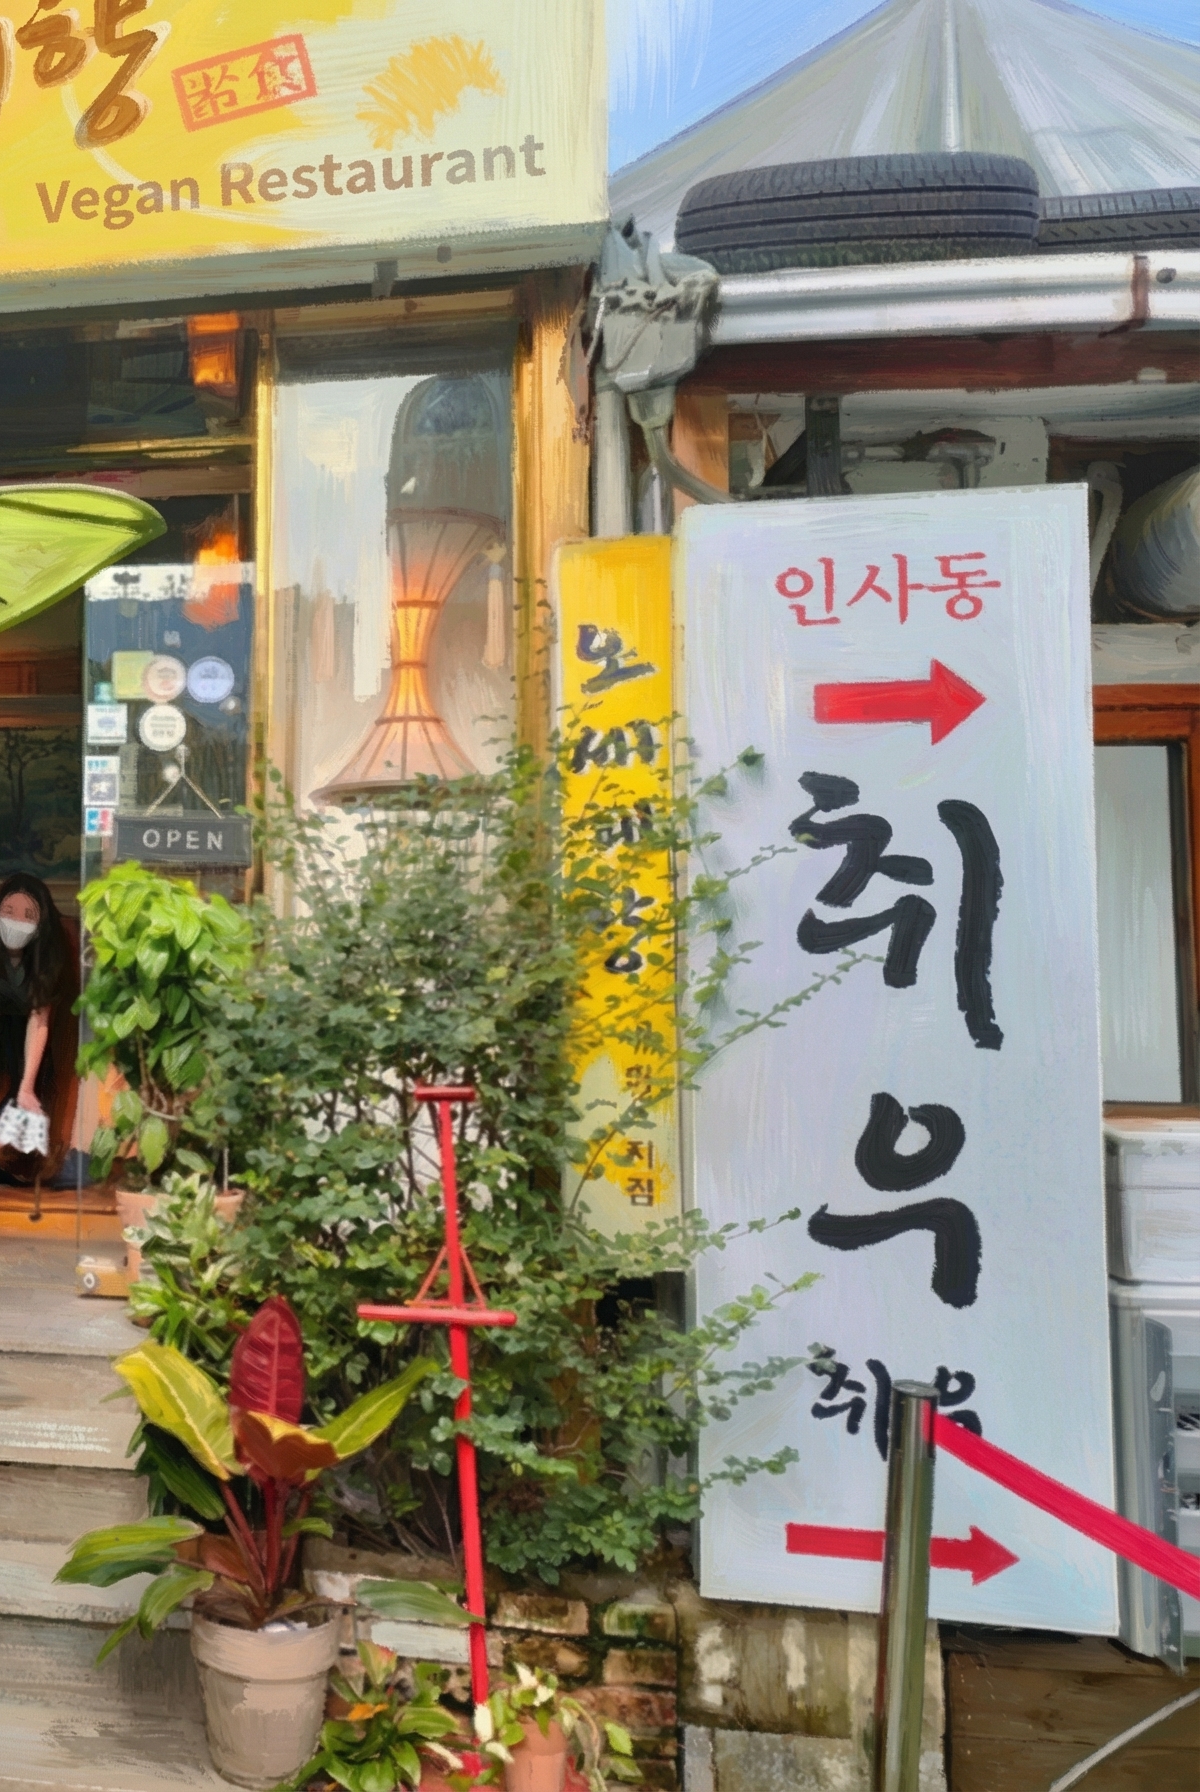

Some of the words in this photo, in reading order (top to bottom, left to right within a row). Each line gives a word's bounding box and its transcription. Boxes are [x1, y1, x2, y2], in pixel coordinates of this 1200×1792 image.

[35, 176, 200, 231] Vegan
[220, 133, 547, 208] Restaurant
[775, 551, 1002, 627] 인사동
[142, 828, 224, 851] OPEN
